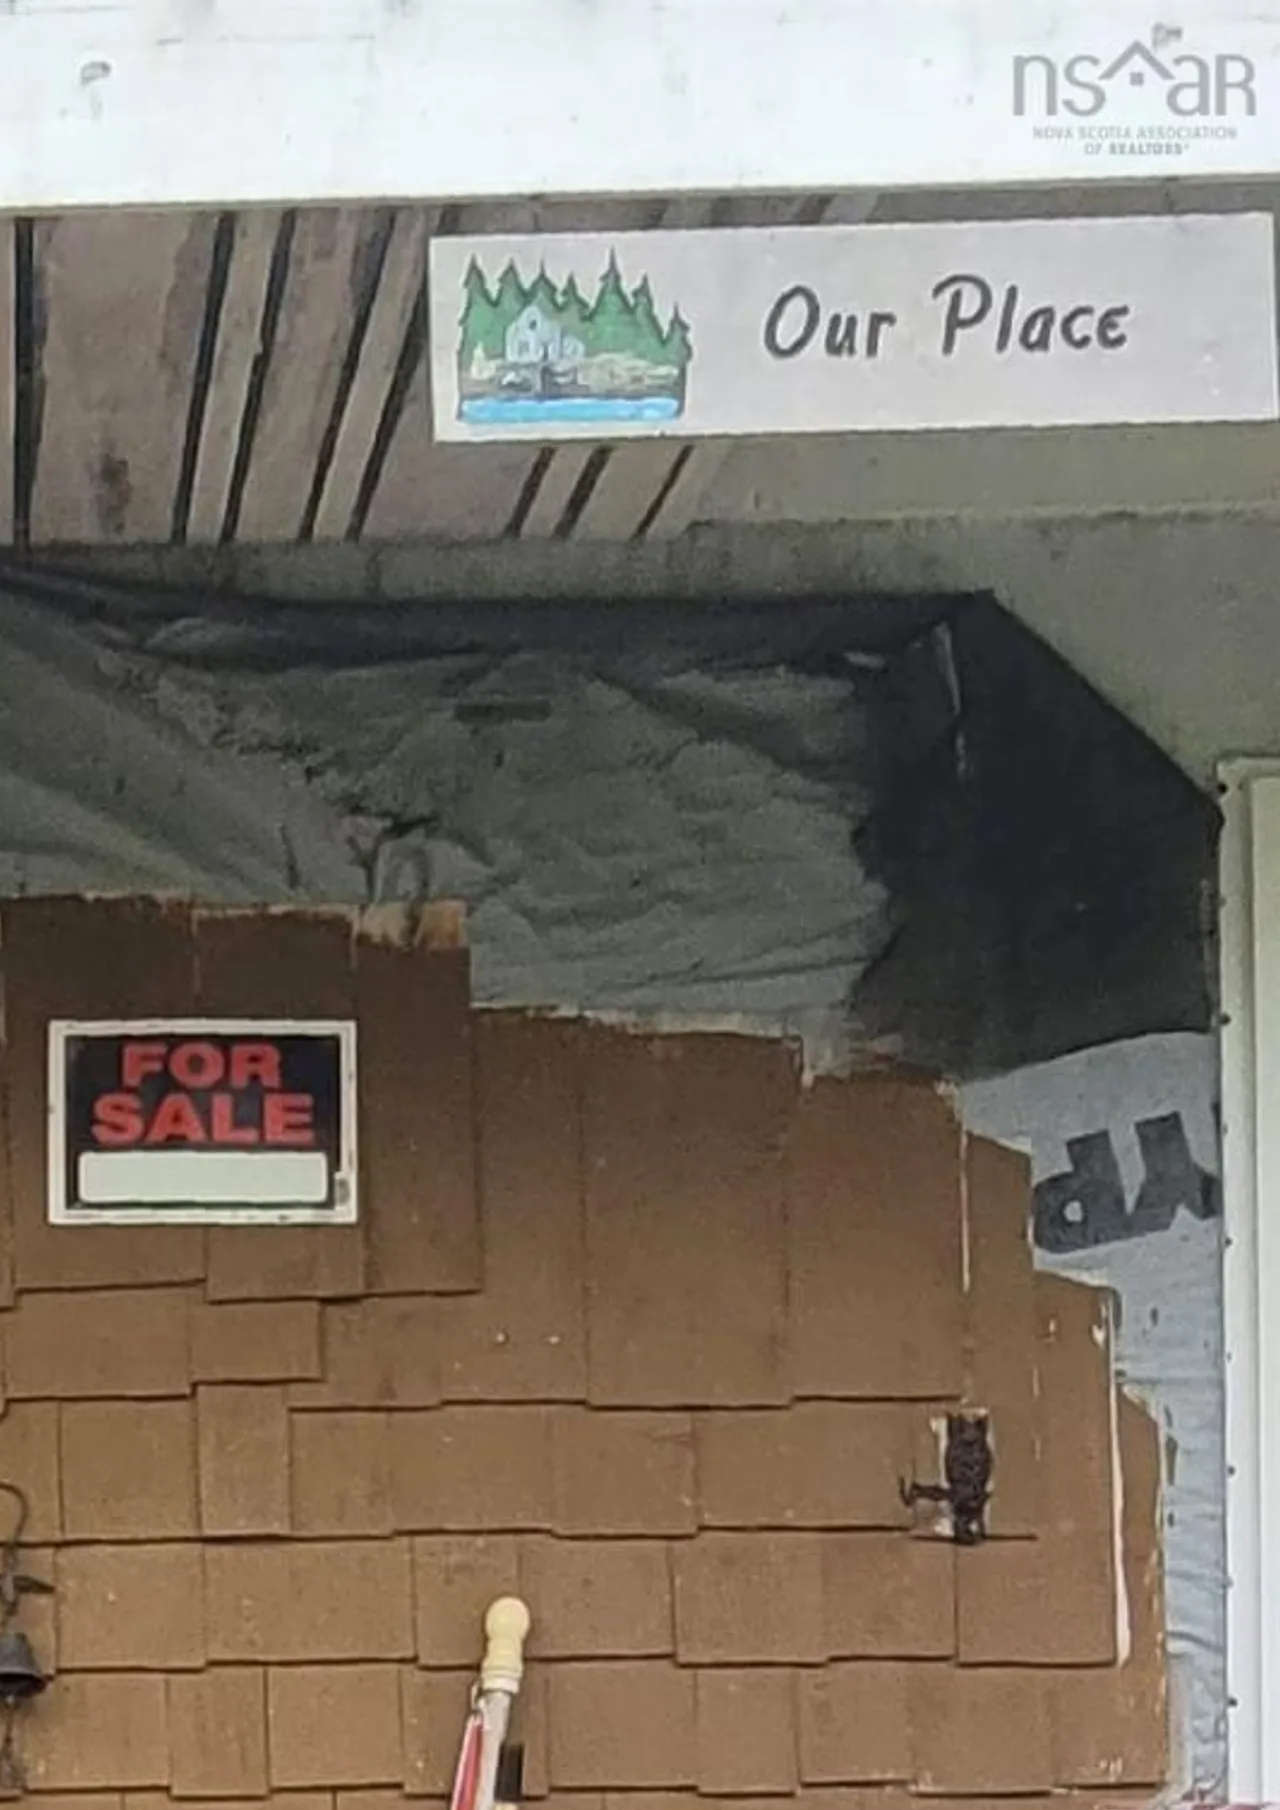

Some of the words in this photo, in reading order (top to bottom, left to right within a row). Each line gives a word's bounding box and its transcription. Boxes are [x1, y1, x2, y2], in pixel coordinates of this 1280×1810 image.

[763, 285, 896, 359] Our
[931, 273, 1129, 357] Place
[122, 1041, 282, 1089] FOR
[92, 1093, 314, 1145] SALE
